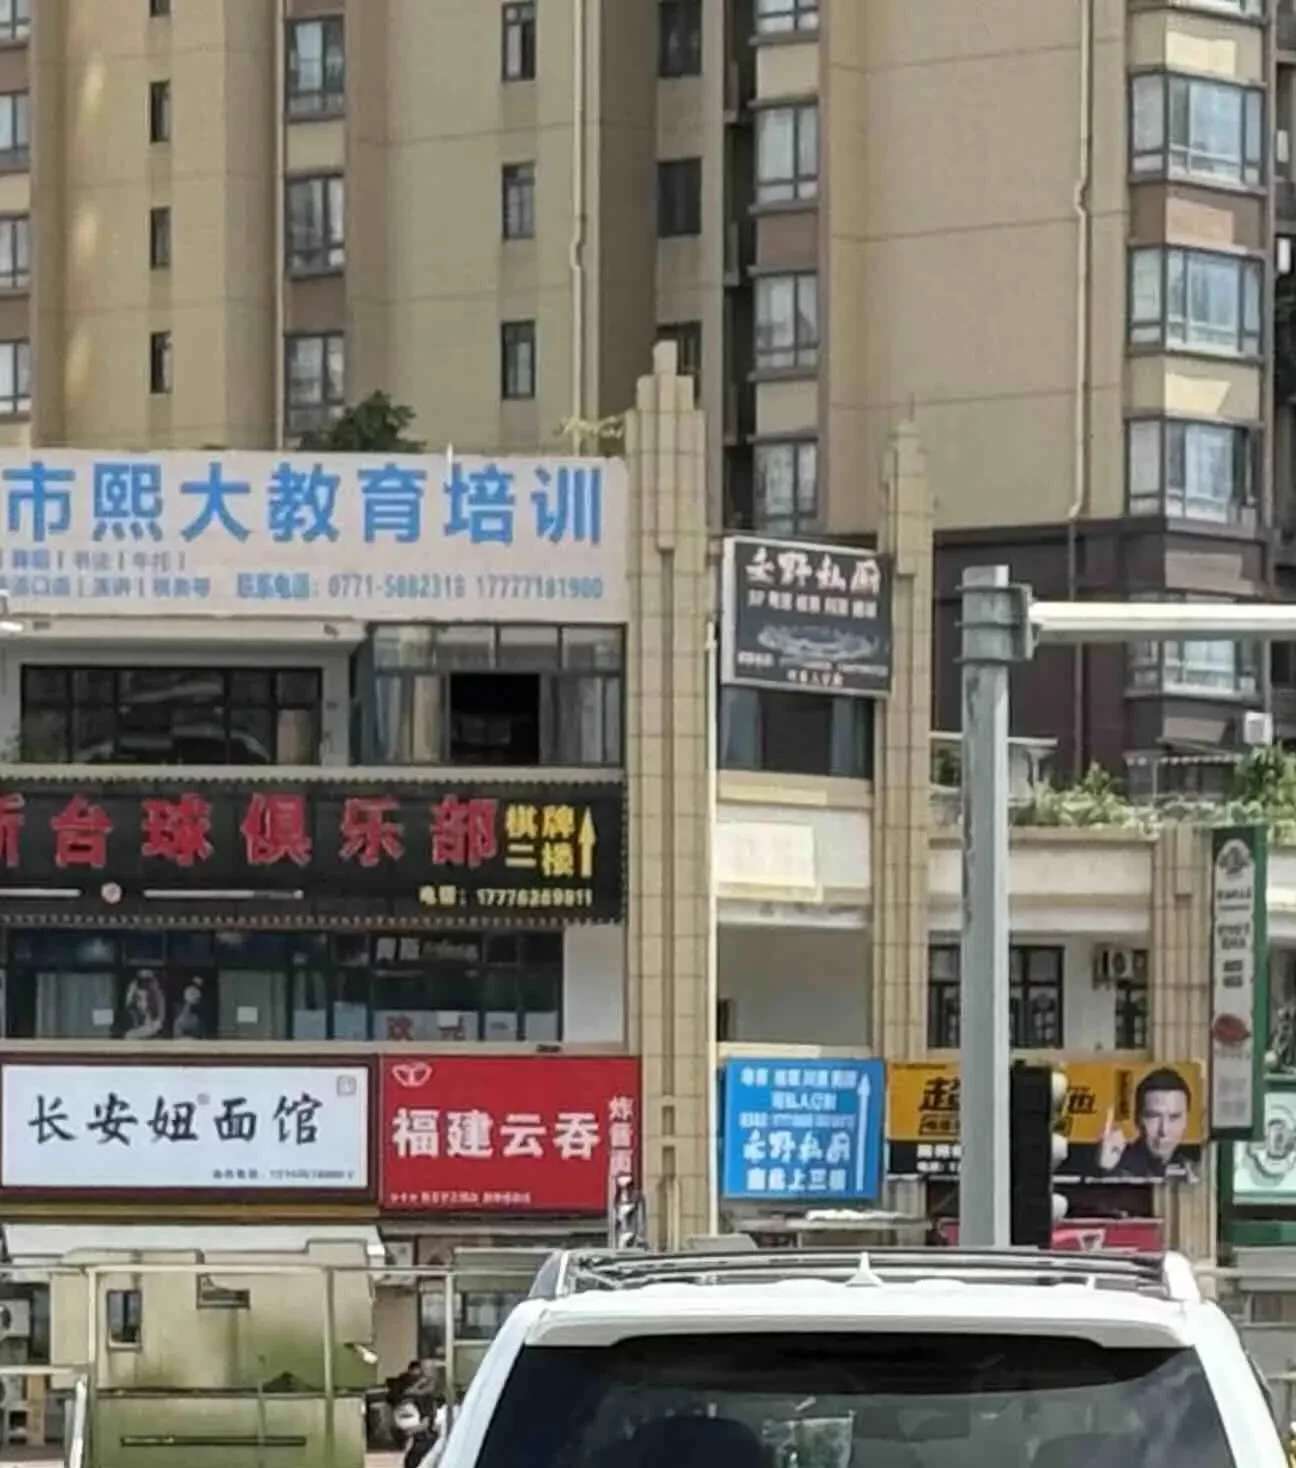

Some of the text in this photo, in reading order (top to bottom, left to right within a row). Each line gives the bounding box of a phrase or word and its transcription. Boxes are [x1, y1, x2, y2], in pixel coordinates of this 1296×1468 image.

[28, 1091, 323, 1147] 长安妞面馆
[392, 1108, 600, 1160] 福建云吞
